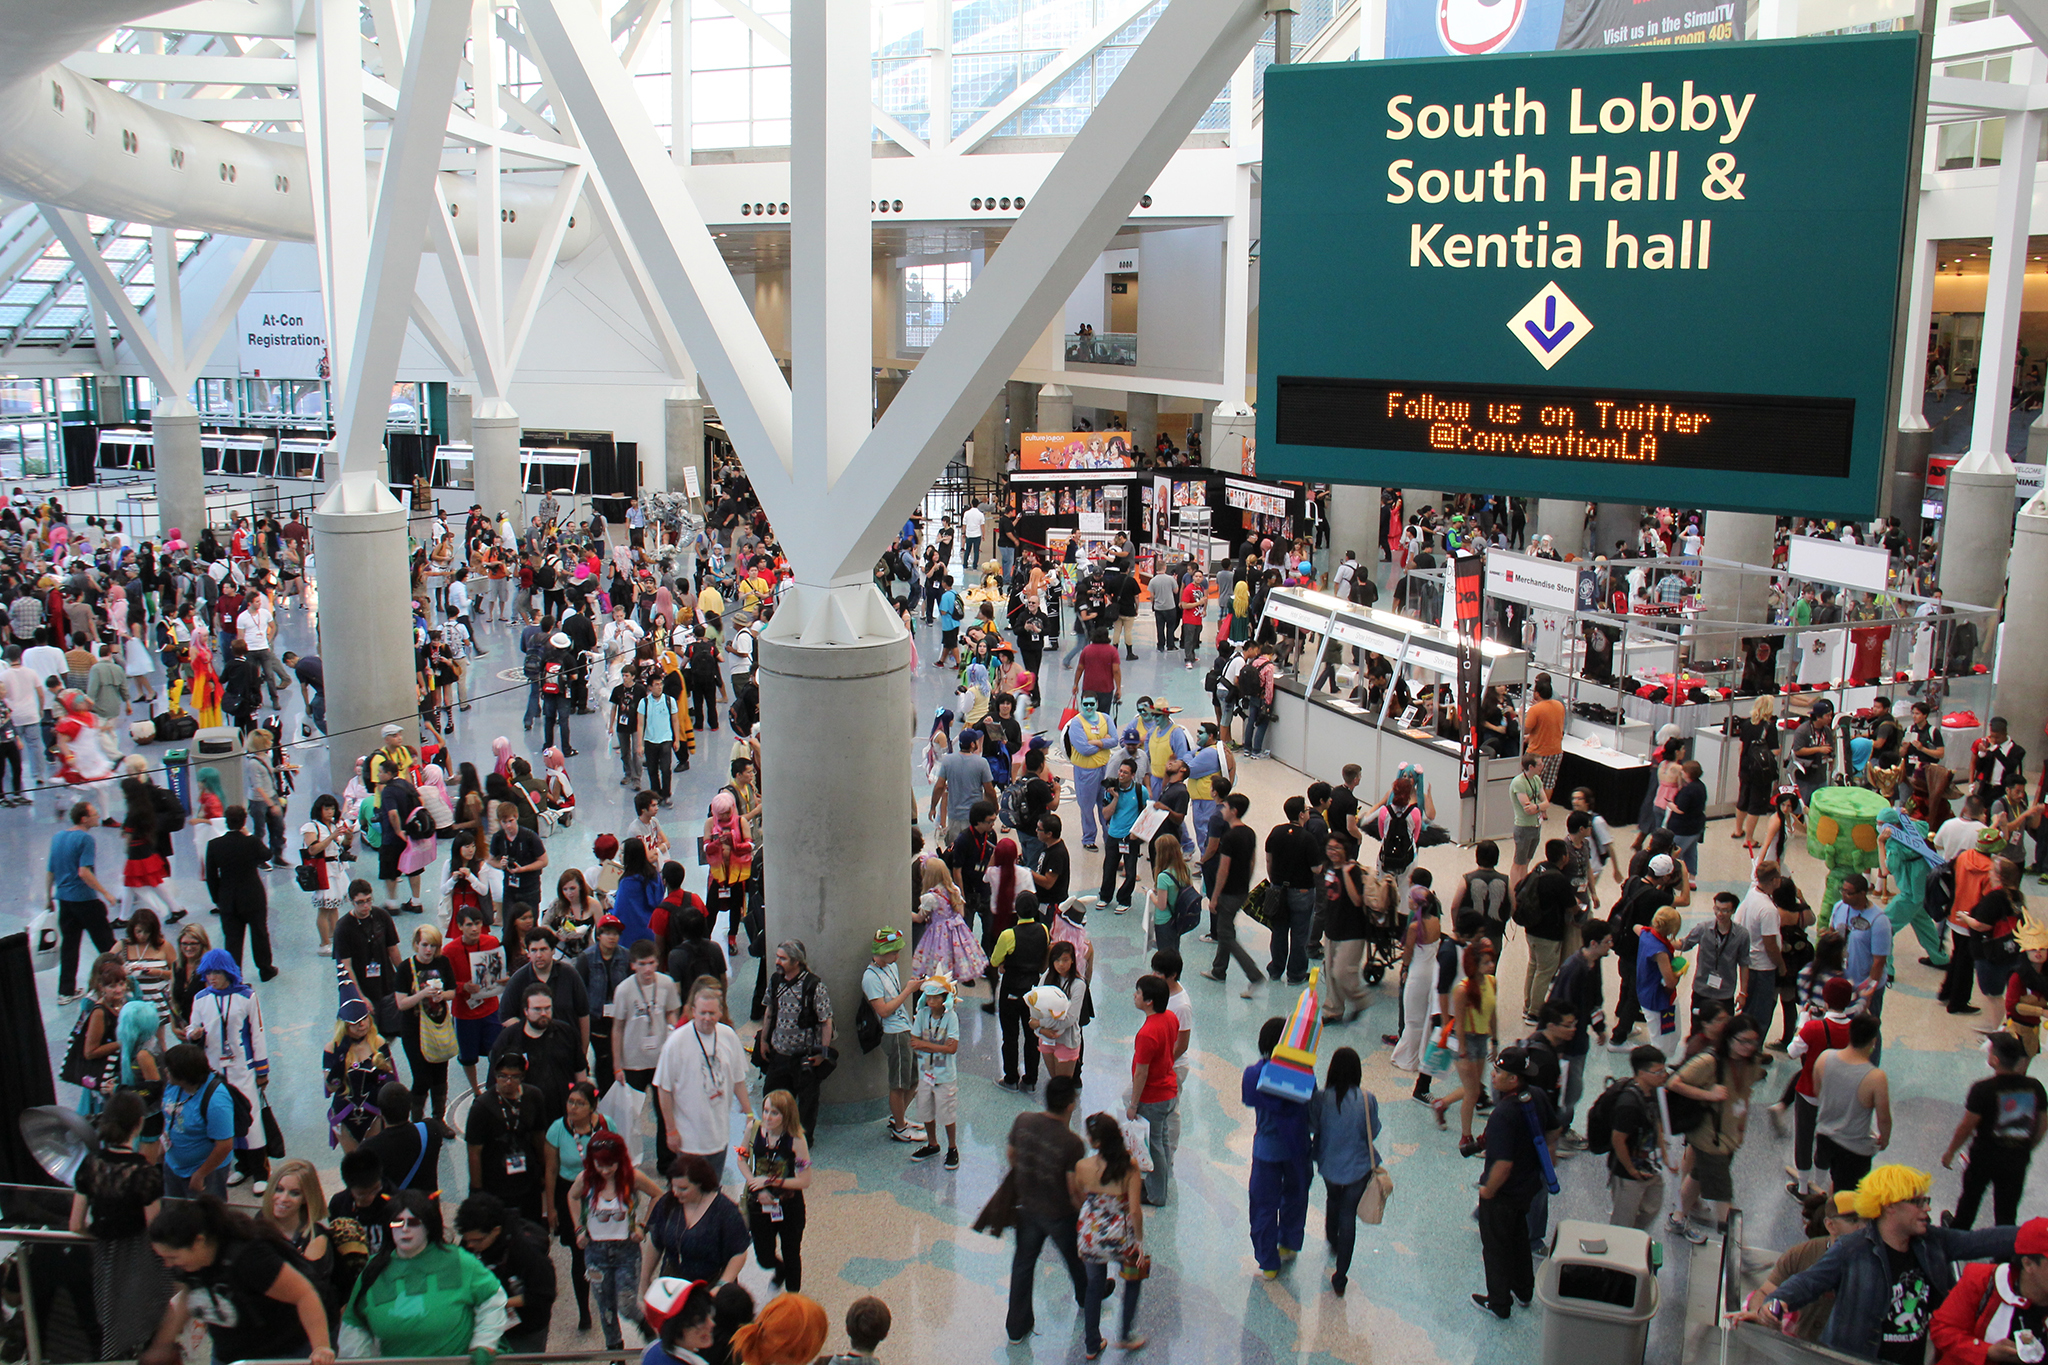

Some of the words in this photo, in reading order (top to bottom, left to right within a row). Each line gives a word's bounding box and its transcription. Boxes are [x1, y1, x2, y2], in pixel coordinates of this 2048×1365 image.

[1603, 25, 1628, 45] Visit
[1630, 25, 1645, 40] us
[1647, 20, 1659, 36] in
[1661, 16, 1681, 33] the
[1683, 3, 1735, 29] SimulTV
[1674, 30, 1706, 45] room
[1708, 22, 1733, 42] 405
[1387, 88, 1546, 140] South
[1570, 80, 1756, 144] Lobby
[1387, 153, 1546, 204] South
[1570, 150, 1678, 202] Hall
[1701, 152, 1746, 201] &
[1410, 220, 1582, 269] Kentia
[1605, 219, 1711, 270] hall
[262, 313, 304, 327] At-Con
[247, 333, 321, 348] Registration
[1387, 392, 1471, 421] Follow
[1488, 403, 1522, 424] us
[1540, 405, 1574, 427] on
[1595, 400, 1711, 434] Twitter
[1024, 434, 1046, 442] culture
[1430, 422, 1656, 461] @ConventionLA
[2016, 478, 2037, 487] NIME
[1514, 574, 1555, 590] Merchandise
[1556, 583, 1575, 594] Store
